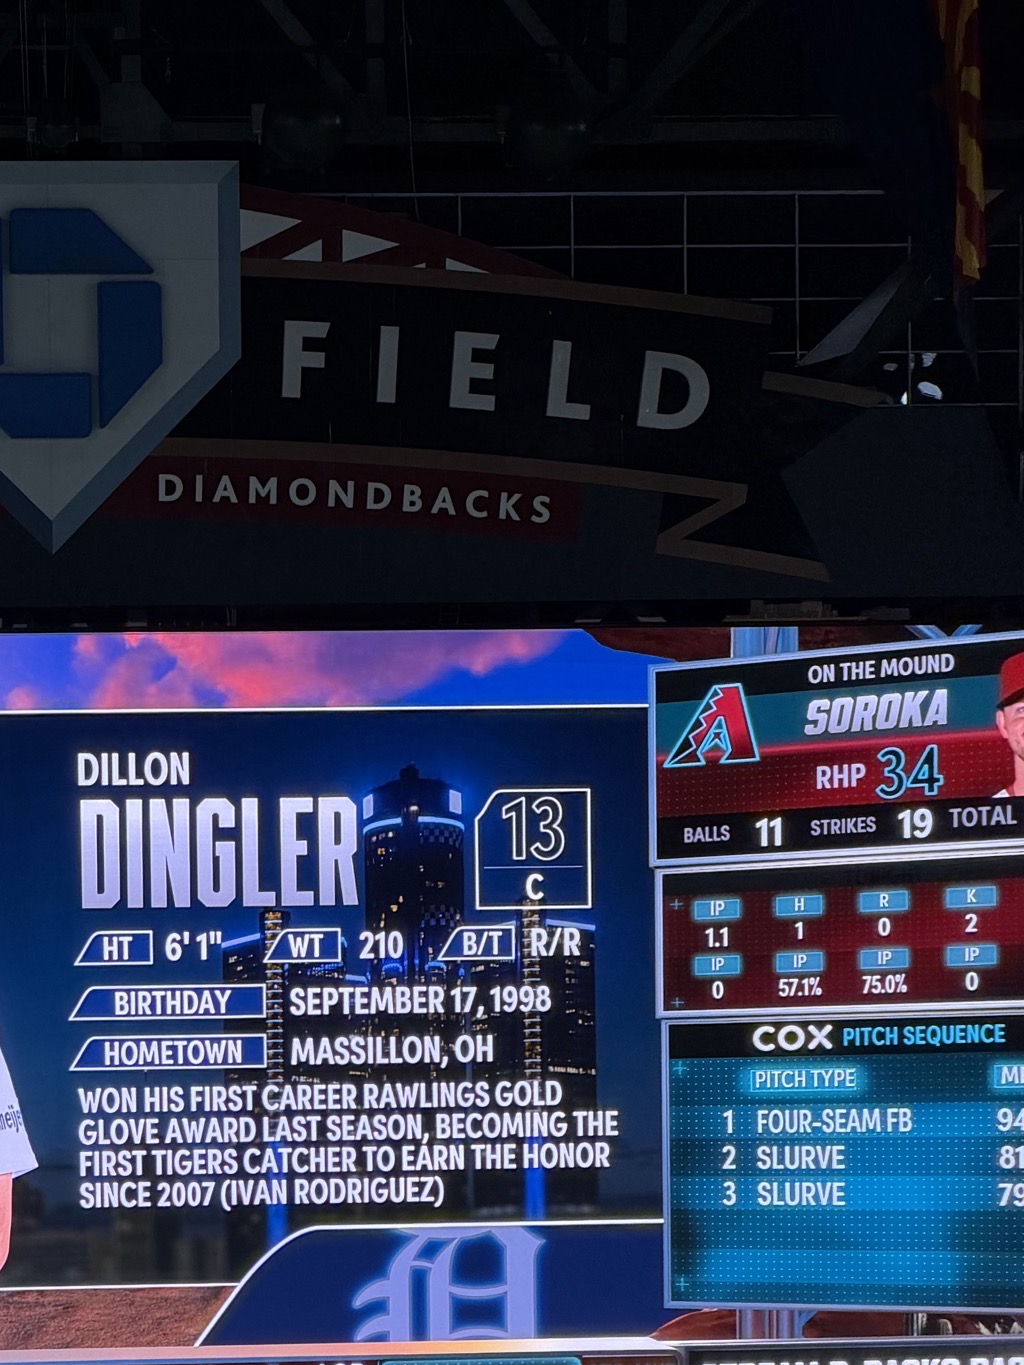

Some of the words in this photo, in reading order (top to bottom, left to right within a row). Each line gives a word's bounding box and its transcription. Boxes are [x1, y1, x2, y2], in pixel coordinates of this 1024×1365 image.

[281, 319, 711, 430] FIELD
[158, 473, 551, 524] DIAMONDBACKS
[807, 663, 835, 684] ON
[839, 660, 876, 681] THE
[880, 653, 955, 678] MOUND
[804, 688, 948, 736] SOROKA
[77, 751, 190, 786] DILLON
[816, 763, 866, 790] RHP
[875, 743, 945, 799] 34
[501, 796, 565, 861] 13
[683, 824, 731, 844] BALLS
[755, 816, 782, 847] 11
[810, 816, 877, 836] STRIKES
[897, 807, 933, 839] 19
[948, 804, 1018, 828] TOTAL
[79, 796, 359, 909] DINGLER
[525, 873, 545, 901] C
[710, 900, 725, 916] IP
[102, 936, 133, 961] HT
[287, 933, 324, 958] WT
[359, 930, 404, 960] 210
[462, 930, 503, 956] B/T
[531, 927, 581, 957] R/R
[705, 926, 729, 948] 1.1
[711, 957, 725, 971] IP
[793, 954, 807, 968] IP
[877, 950, 892, 965] IP
[964, 946, 980, 962] IP
[114, 989, 232, 1016] BIRTHDAY
[289, 985, 445, 1016] SEPTEMBER
[450, 986, 488, 1020] 17,
[489, 985, 552, 1013] 1998
[778, 976, 823, 997] 57.1%
[862, 973, 908, 994] 75.0%
[104, 1039, 242, 1066] HOMETOWN
[290, 1033, 449, 1069] MASSILLON,
[454, 1035, 495, 1064] OH
[752, 1024, 833, 1052] COX
[843, 1026, 899, 1047] PITCH
[902, 1023, 1006, 1047] SEQUENCE
[755, 1069, 806, 1088] PITCH
[810, 1068, 856, 1087] TYPE
[77, 1087, 137, 1114] WON
[144, 1086, 185, 1113] HIS
[190, 1084, 258, 1112] FIRST
[261, 1083, 357, 1111] CAREER
[363, 1081, 491, 1109] RAWLINGS
[494, 1079, 563, 1107] GOLD
[78, 1118, 160, 1146] GLOVE
[164, 1116, 257, 1144] AWARD
[262, 1115, 322, 1142] LAST
[326, 1113, 430, 1145] SEASON,
[435, 1110, 568, 1139] BECOMING
[572, 1110, 619, 1137] THE
[757, 1108, 882, 1134] FOUR-SEAM
[886, 1107, 913, 1132] FB
[79, 1149, 147, 1177] FIRST
[151, 1148, 239, 1176] TIGERS
[243, 1146, 357, 1175] CATCHER
[361, 1145, 396, 1172] TO
[401, 1144, 465, 1171] EARN
[470, 1143, 517, 1170] THE
[522, 1141, 611, 1169] HONOR
[756, 1145, 846, 1170] SLURVE
[79, 1181, 152, 1209] SINCE
[156, 1181, 216, 1207] 2007
[220, 1178, 288, 1212] (IVAN
[294, 1175, 445, 1208] RODRIGUEZ)
[757, 1181, 846, 1206] SLURVE
